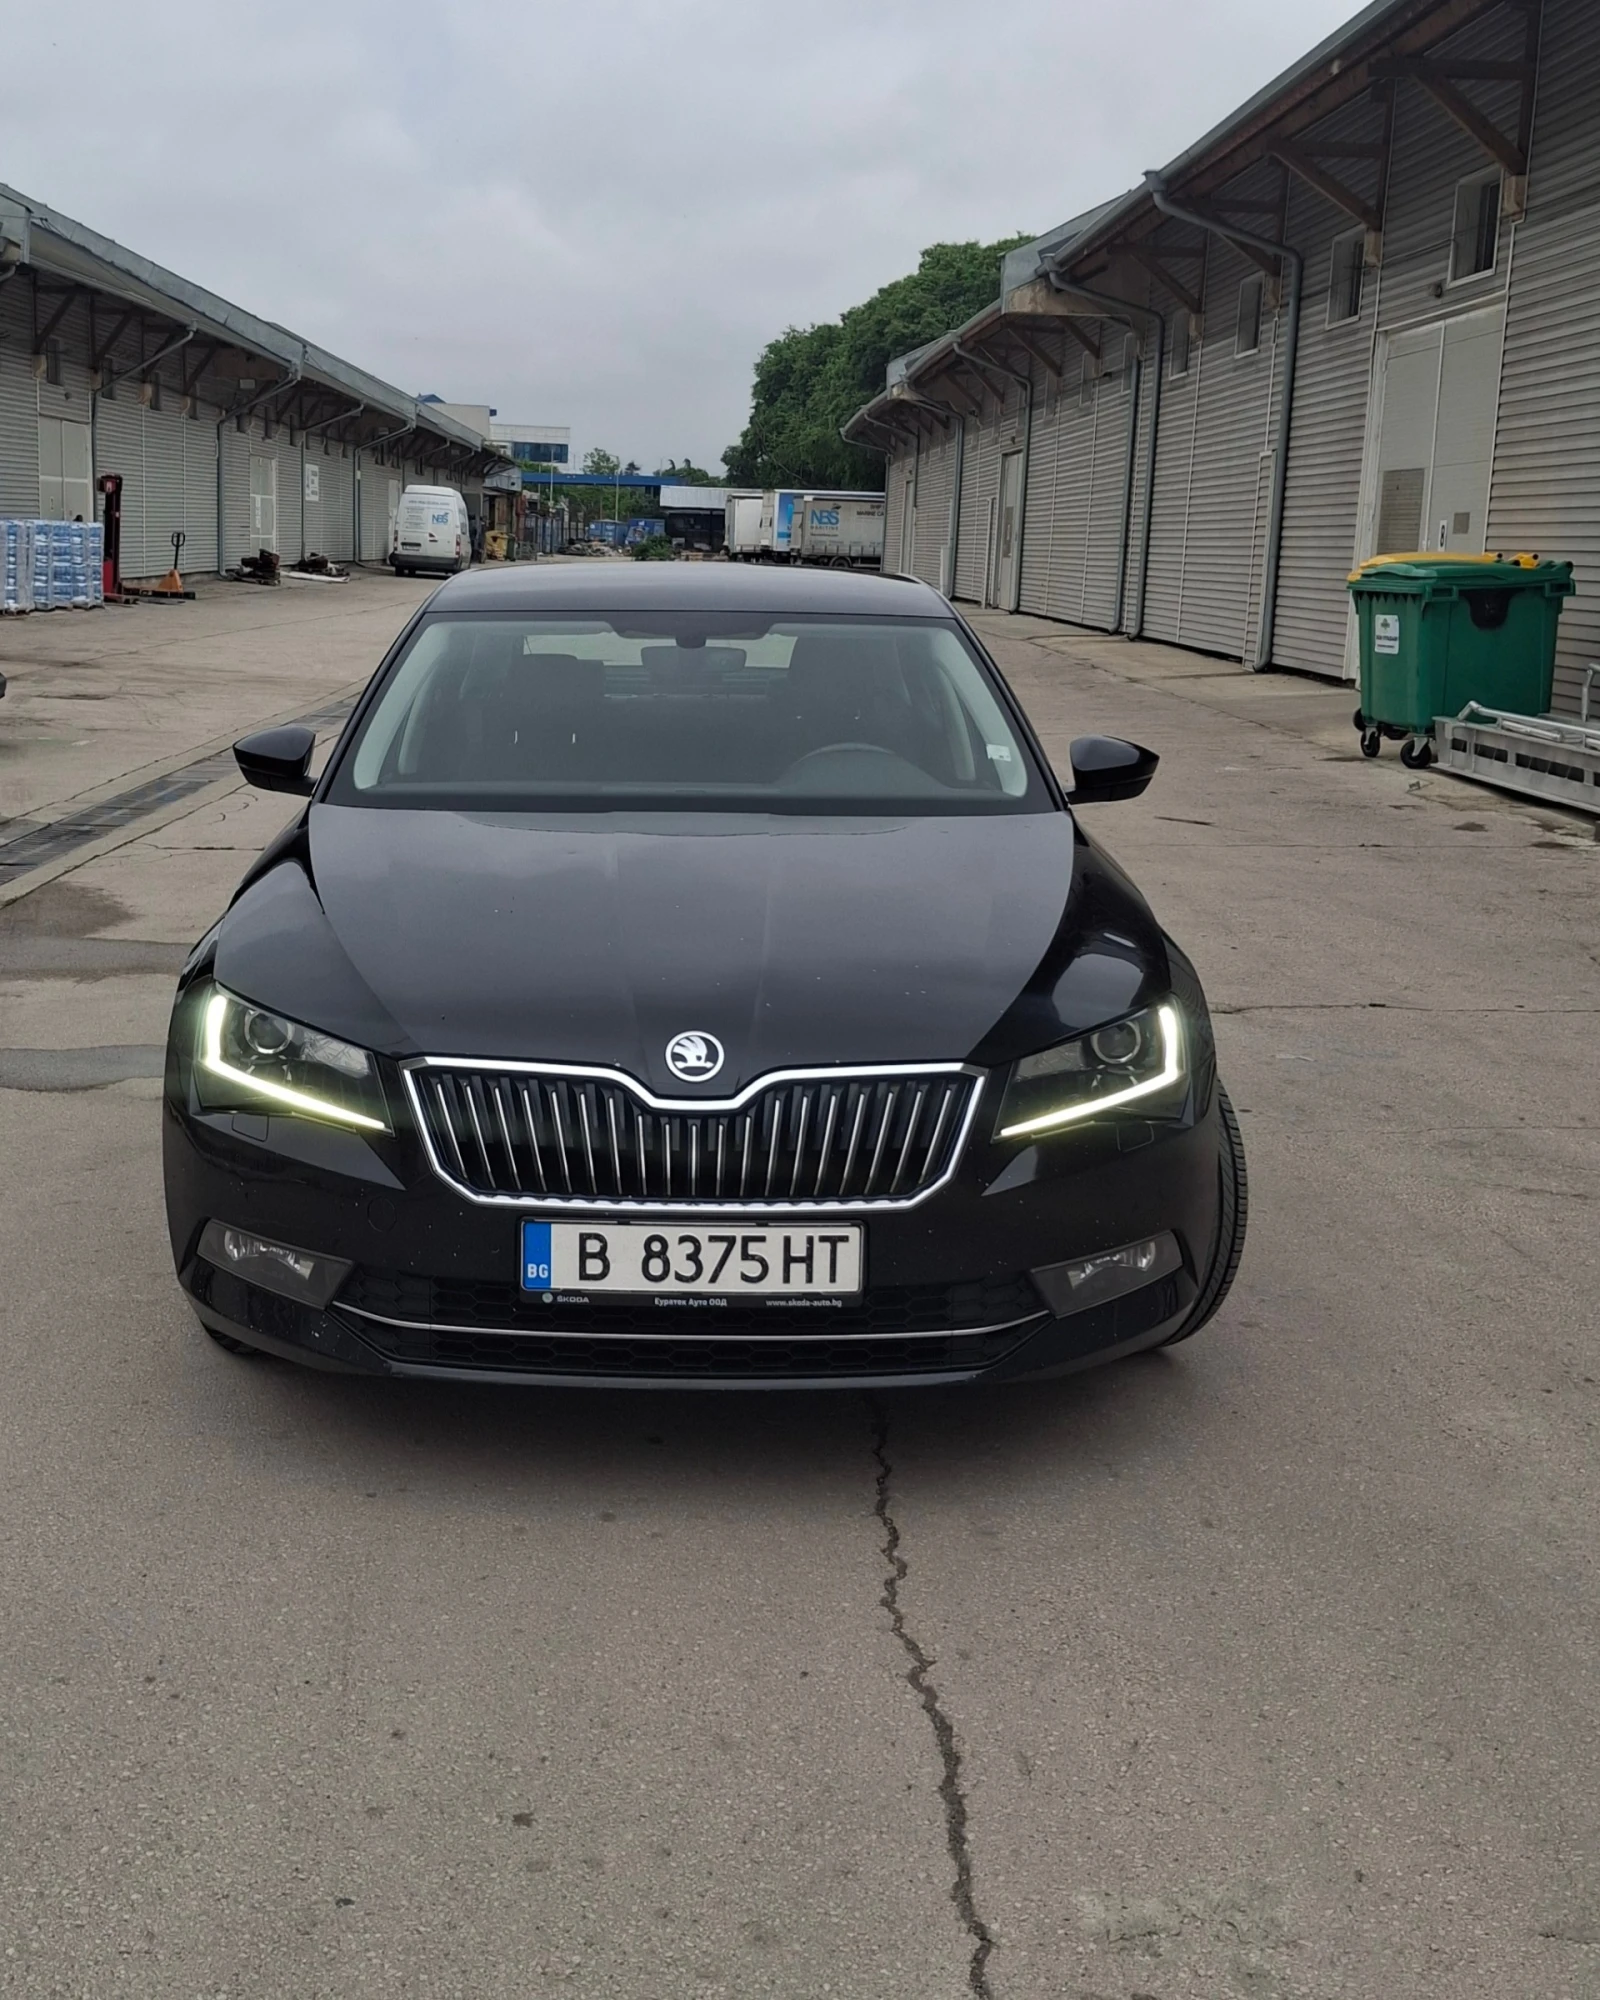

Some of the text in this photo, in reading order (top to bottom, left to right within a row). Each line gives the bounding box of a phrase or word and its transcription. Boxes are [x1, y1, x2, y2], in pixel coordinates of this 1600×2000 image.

[432, 513, 449, 525] NBS
[810, 509, 840, 525] NBS
[579, 1232, 850, 1284] B 8375 HT
[527, 1263, 549, 1278] BG
[688, 1297, 708, 1308] Ауто
[709, 1297, 728, 1307] ООД
[765, 1297, 843, 1308] www.skoda-auto.bg
